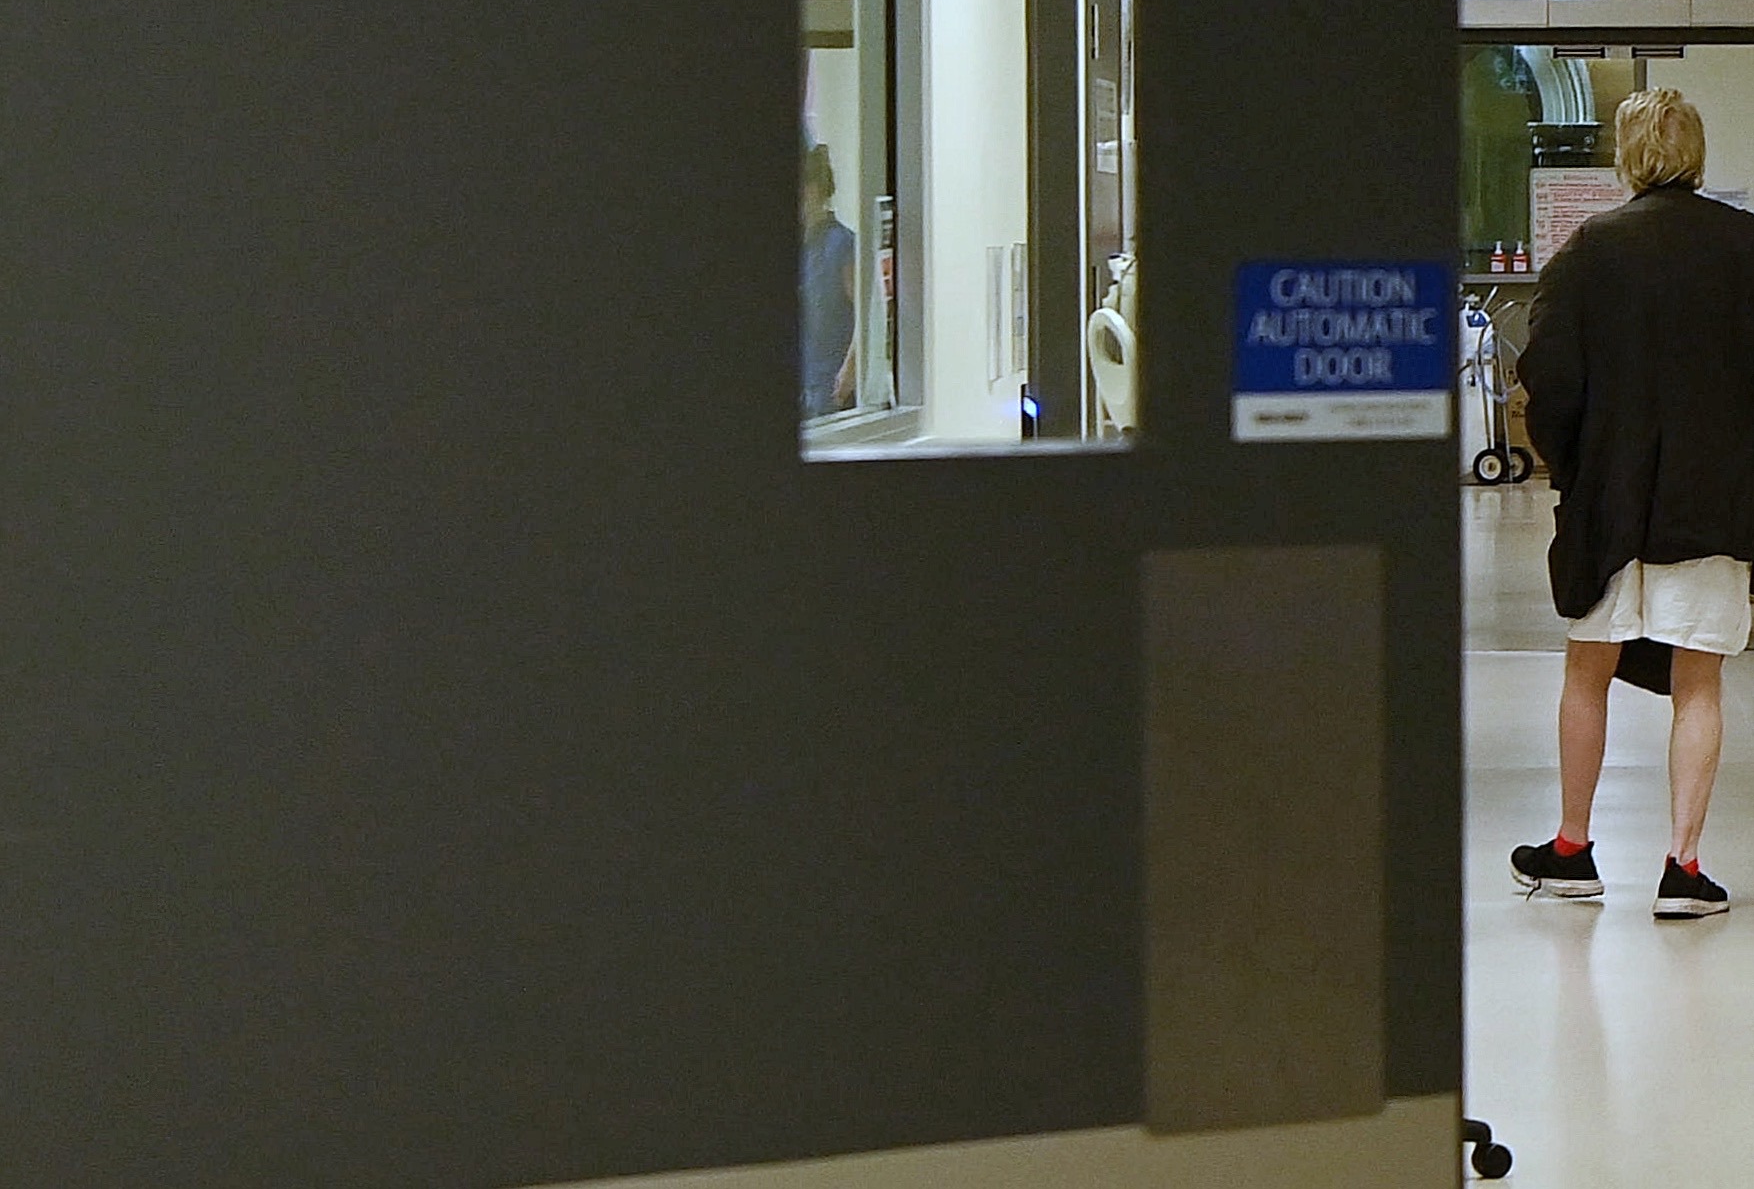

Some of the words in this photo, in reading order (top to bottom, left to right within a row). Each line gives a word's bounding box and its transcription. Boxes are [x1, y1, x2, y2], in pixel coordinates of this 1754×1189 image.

[1269, 267, 1417, 308] CAUTION
[1247, 307, 1439, 346] AUTOMATIC
[1293, 347, 1394, 386] DOOR
